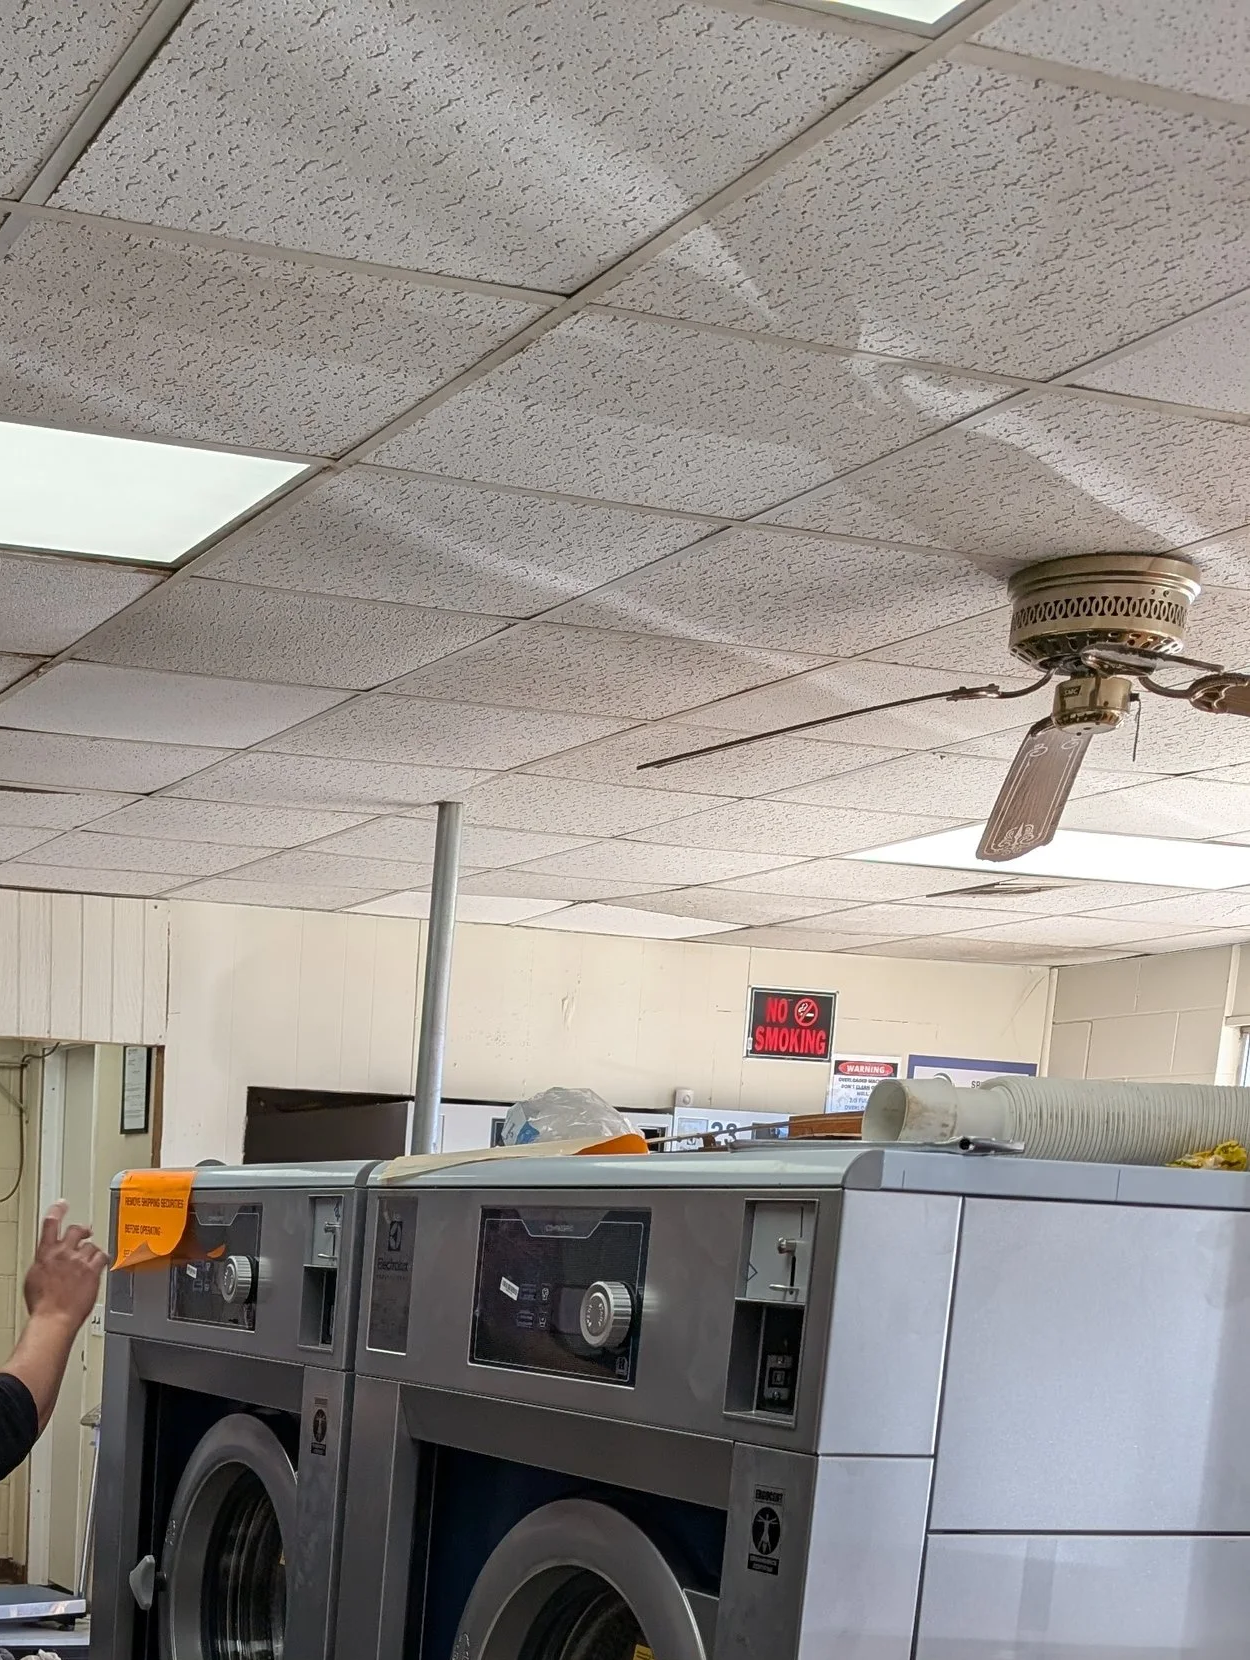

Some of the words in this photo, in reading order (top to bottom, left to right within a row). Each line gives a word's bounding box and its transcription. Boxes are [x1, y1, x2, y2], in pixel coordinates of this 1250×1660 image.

[766, 997, 788, 1024] NO
[754, 1025, 827, 1055] SMOKING
[846, 1064, 886, 1074] WARNING
